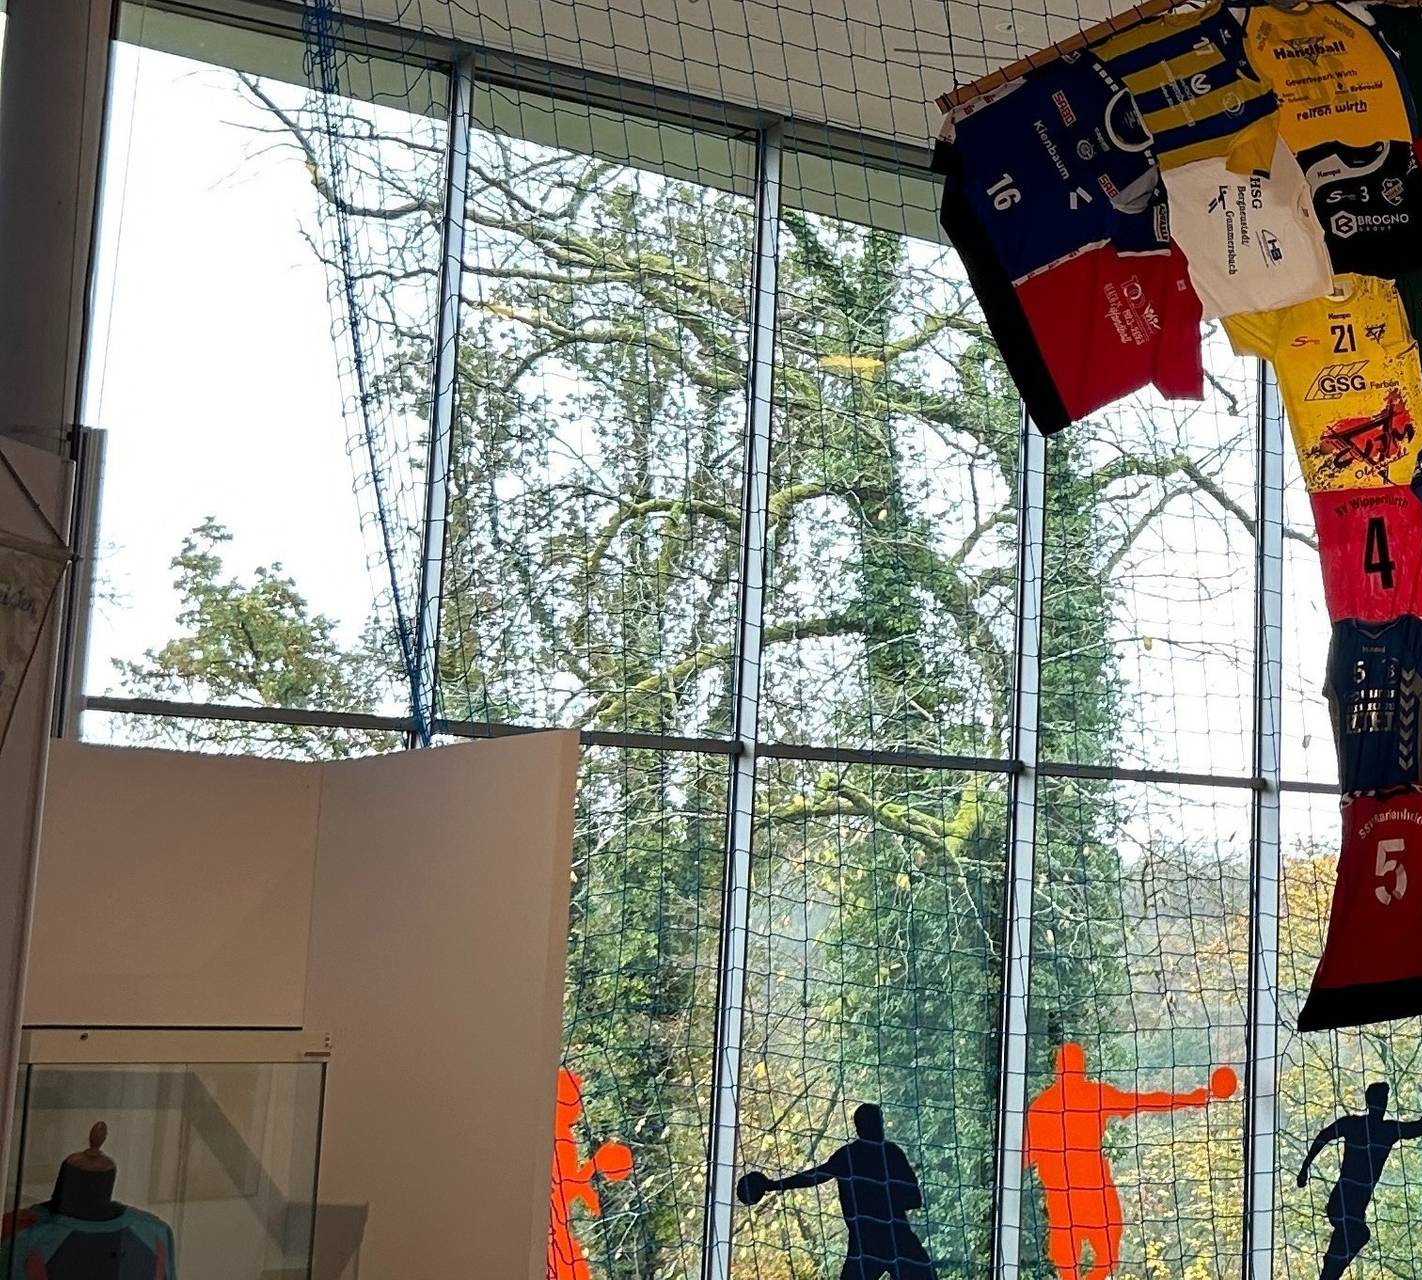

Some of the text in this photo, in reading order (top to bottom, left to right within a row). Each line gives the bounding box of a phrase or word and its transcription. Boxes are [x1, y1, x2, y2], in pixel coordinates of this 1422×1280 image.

[1273, 40, 1347, 60] Handball
[1296, 101, 1368, 121] reifen wirth
[1033, 120, 1070, 180] Kienbaum
[986, 173, 1022, 211] 16
[1099, 175, 1119, 199] SAB
[1250, 177, 1263, 210] HSG
[1360, 186, 1370, 202] 3
[1357, 213, 1410, 226] BROGNO
[1331, 323, 1356, 353] 21
[1320, 374, 1366, 393] GSG
[1364, 516, 1396, 590] 4
[1374, 837, 1408, 906] 5
